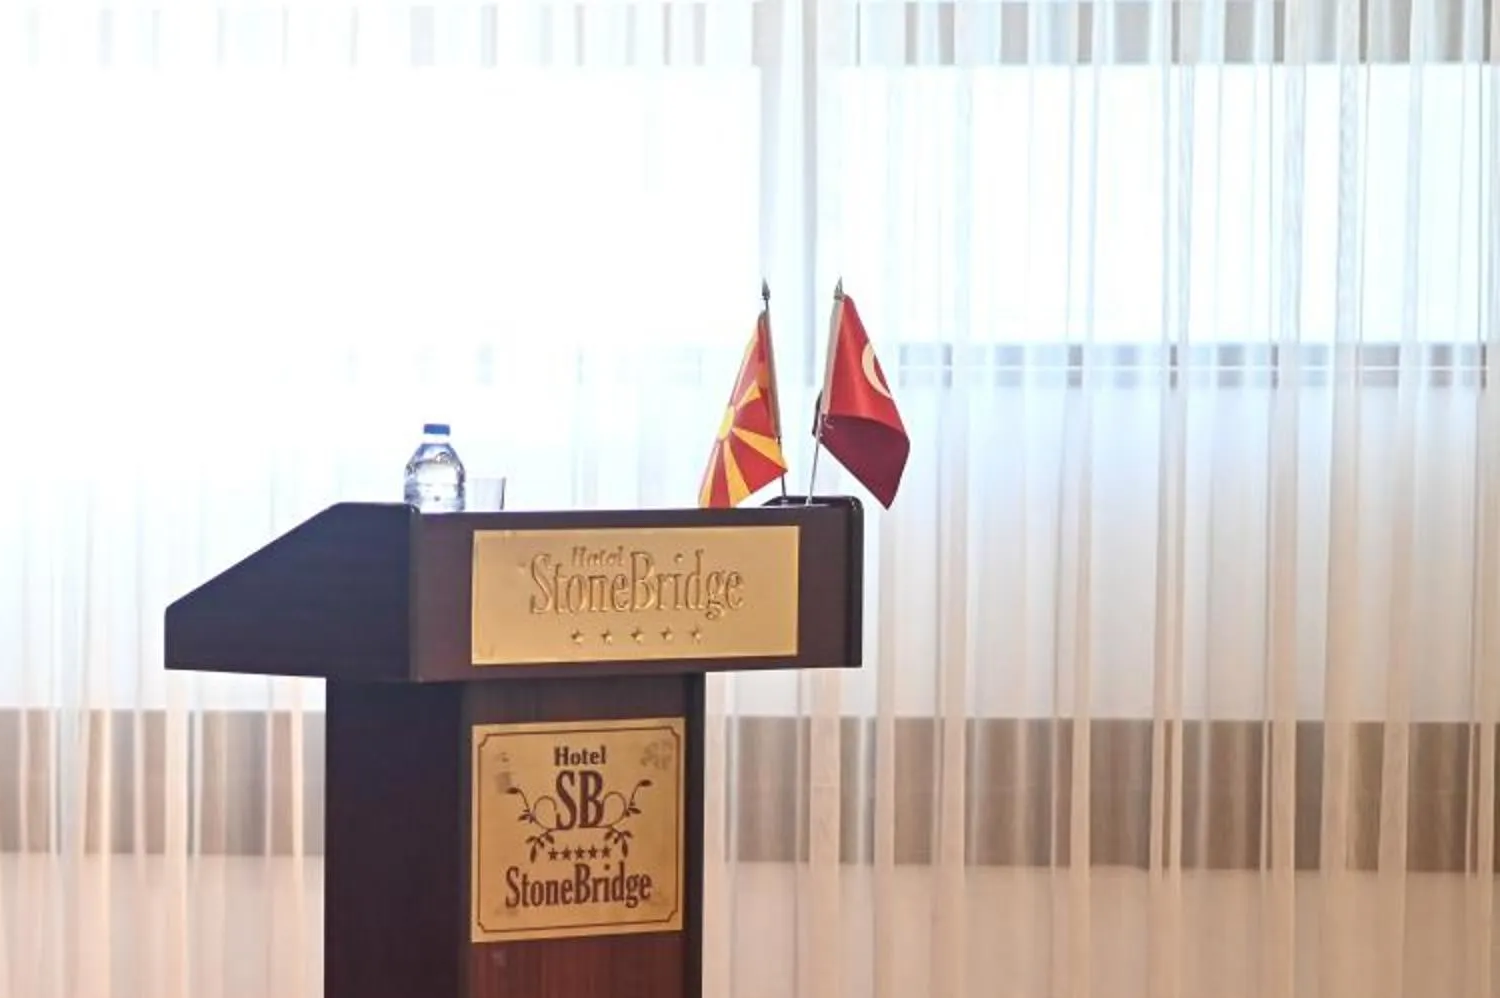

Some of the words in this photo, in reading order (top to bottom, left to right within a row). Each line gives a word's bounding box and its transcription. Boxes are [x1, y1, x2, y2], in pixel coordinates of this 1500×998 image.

[572, 545, 625, 567] Hotel
[529, 548, 744, 620] StoneBridge
[553, 745, 607, 767] Hotel
[555, 770, 605, 831] SB
[505, 862, 652, 909] StoneBridge
